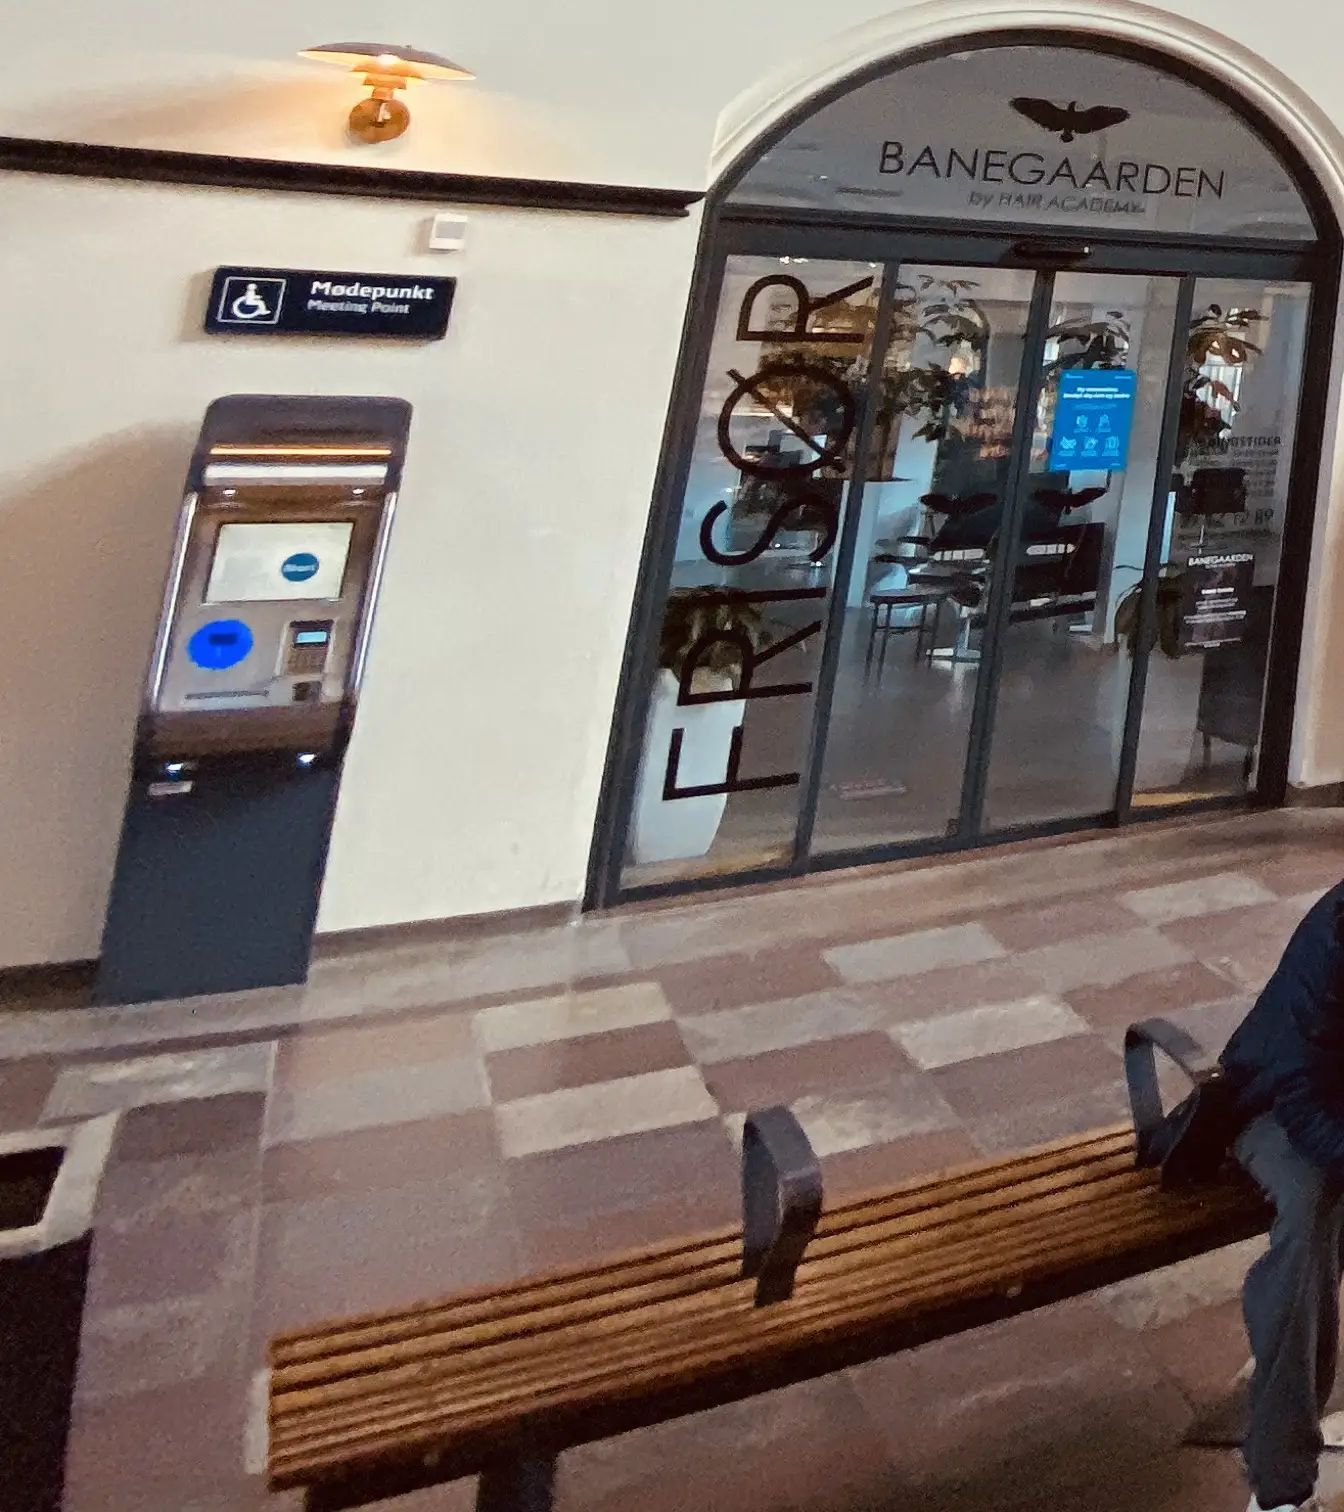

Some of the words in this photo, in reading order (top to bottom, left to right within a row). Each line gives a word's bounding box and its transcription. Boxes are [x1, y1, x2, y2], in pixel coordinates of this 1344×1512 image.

[878, 140, 1225, 200] BANEGAARDEN
[1000, 192, 1043, 208] HAIR
[310, 280, 435, 301] Mødepunkt
[307, 299, 367, 314] Meeting
[371, 299, 410, 314] Point
[663, 274, 875, 801] FRISØR
